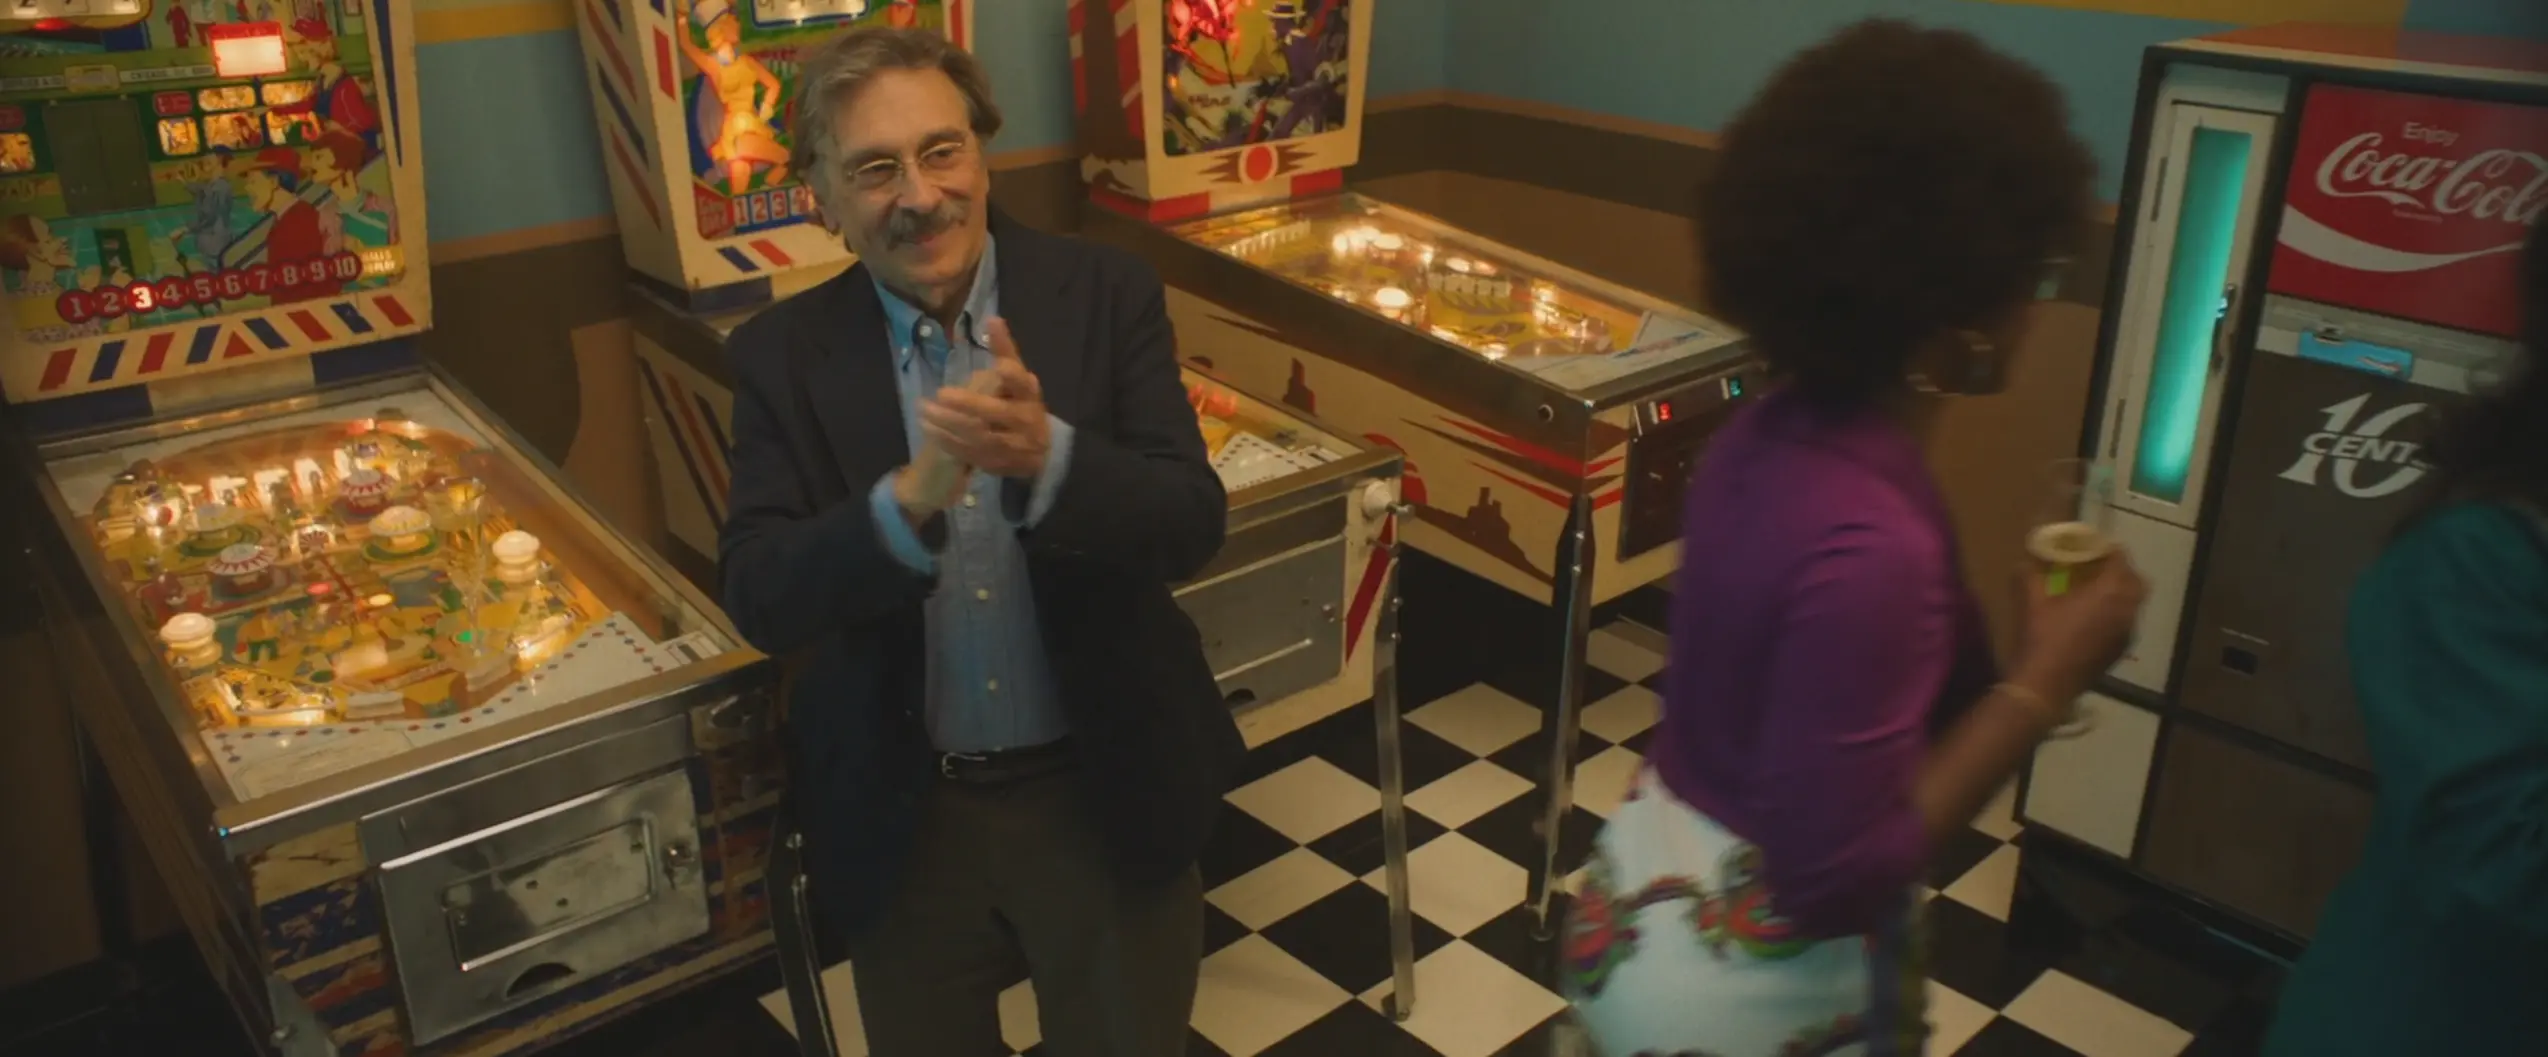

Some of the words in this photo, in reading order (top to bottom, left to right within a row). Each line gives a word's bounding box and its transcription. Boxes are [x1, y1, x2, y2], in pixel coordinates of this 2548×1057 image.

[2403, 121, 2460, 147] Enjoy
[70, 297, 84, 318] 1
[102, 291, 120, 312] 2
[132, 286, 152, 309] 3
[162, 283, 181, 303] 4
[194, 278, 211, 299] 5
[223, 274, 241, 295] 6
[255, 269, 268, 290] 7
[282, 265, 298, 285] 8
[310, 259, 326, 281] 9
[333, 255, 357, 278] 10
[2303, 431, 2437, 470] CENT
